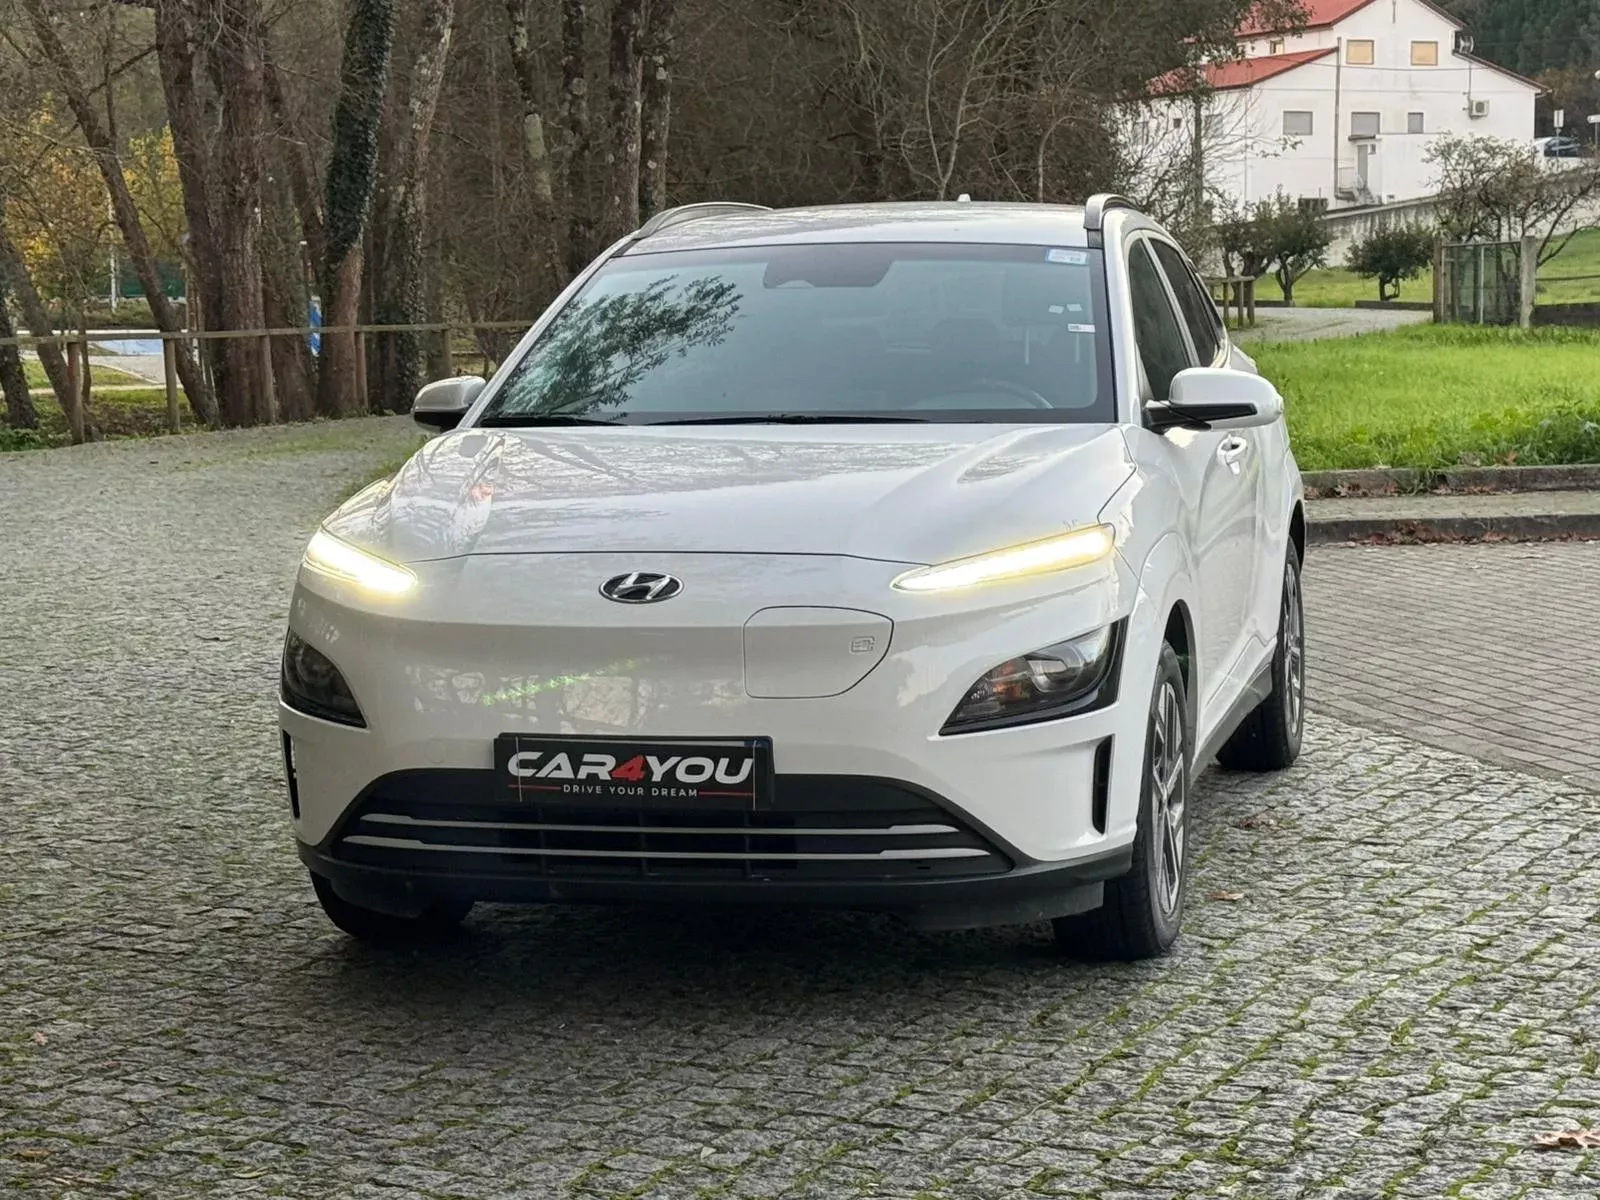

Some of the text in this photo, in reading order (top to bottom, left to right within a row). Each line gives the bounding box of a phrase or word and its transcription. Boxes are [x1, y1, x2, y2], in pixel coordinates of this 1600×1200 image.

[507, 751, 753, 784] CAR4YOU
[563, 784, 697, 797] DRIVE YOUR DREAM
